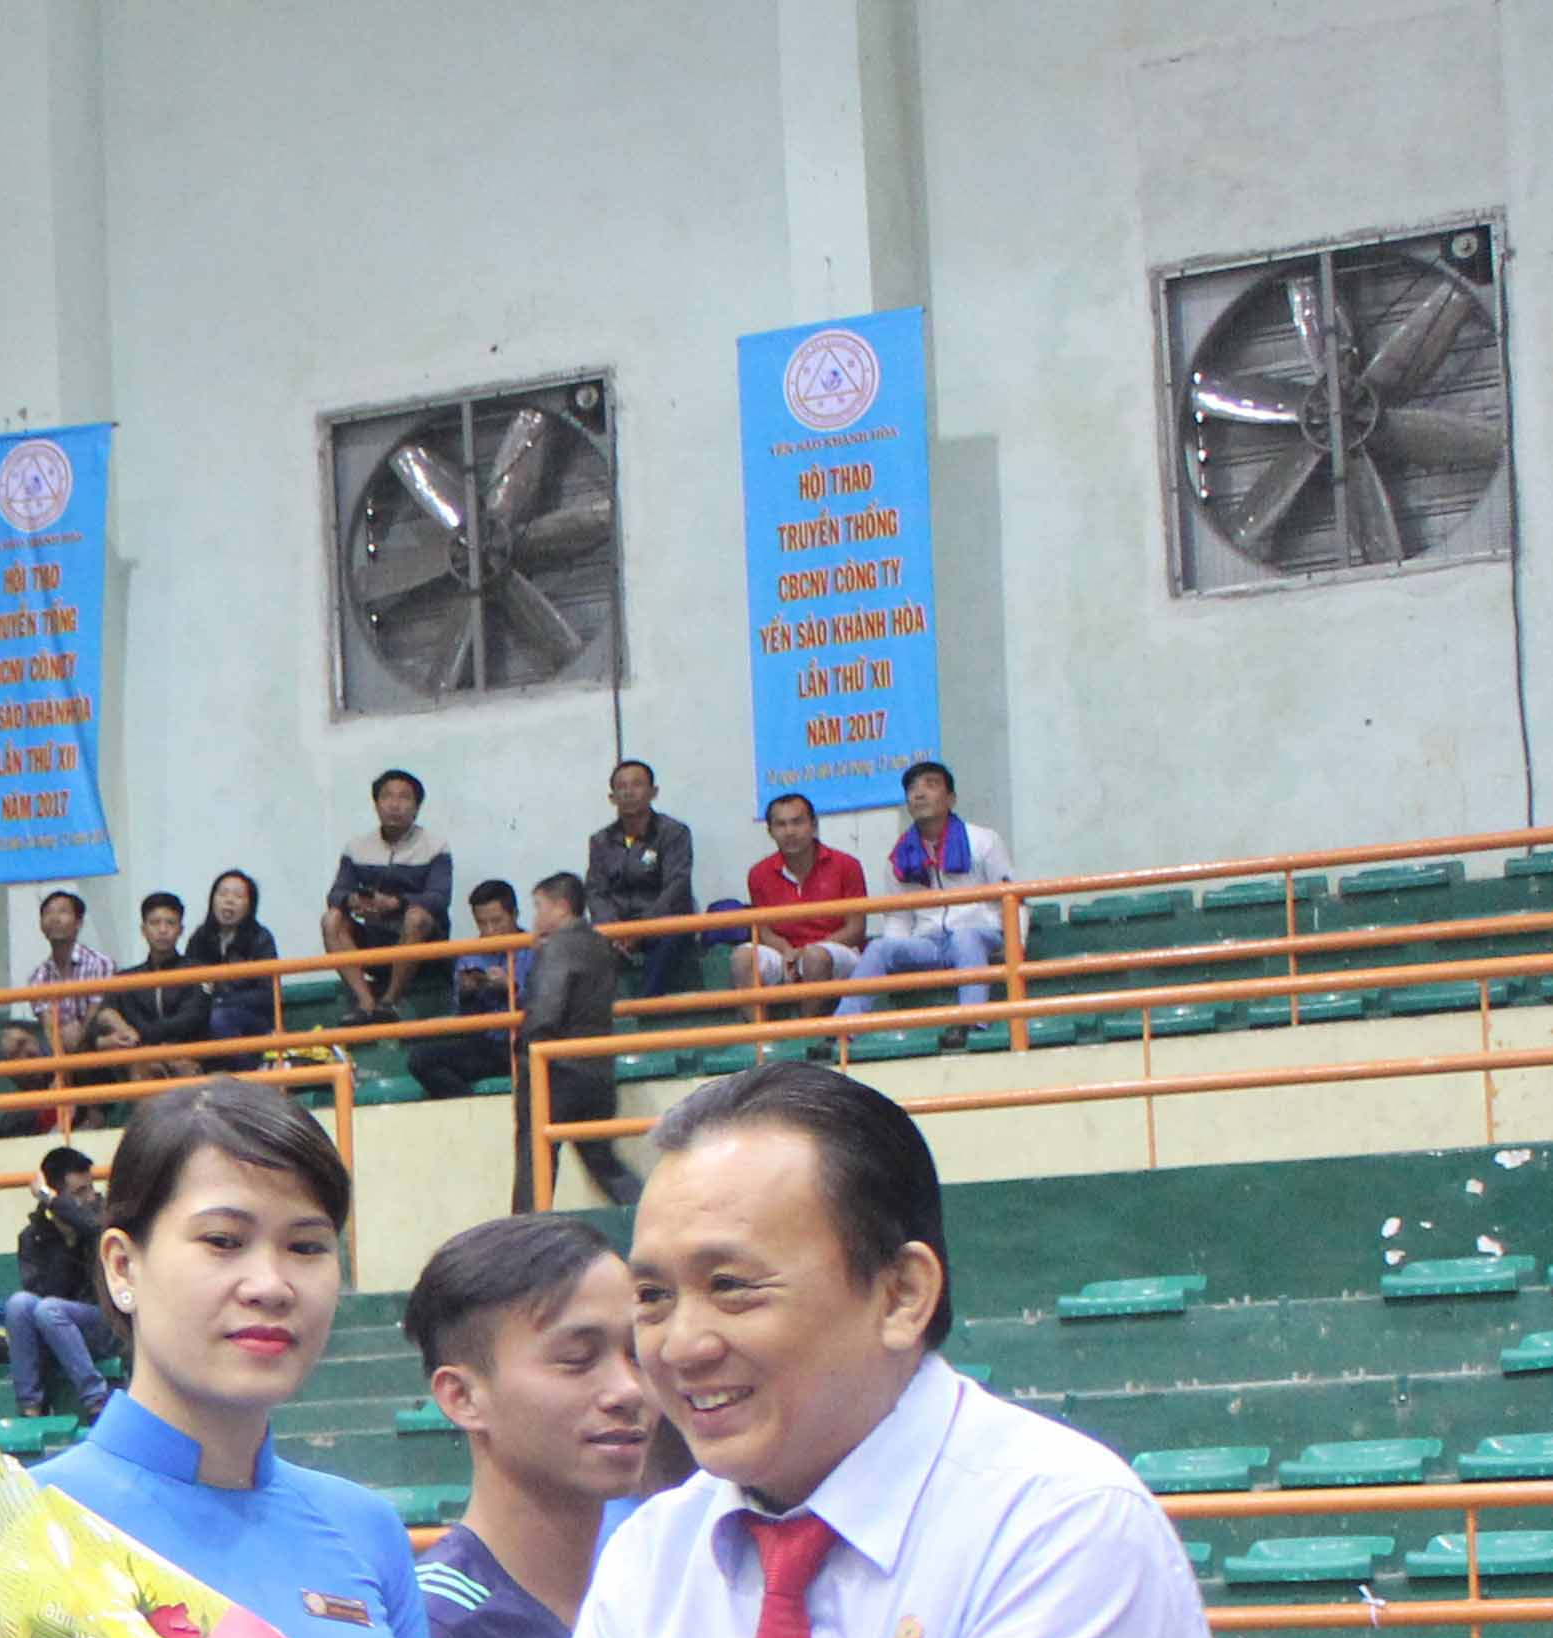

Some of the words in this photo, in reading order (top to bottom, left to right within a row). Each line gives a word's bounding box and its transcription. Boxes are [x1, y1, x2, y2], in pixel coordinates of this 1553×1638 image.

[798, 465, 826, 501] HỘI
[829, 461, 873, 495] THAO
[842, 499, 898, 543] THỐNG
[778, 570, 831, 603] CBCNV
[833, 561, 878, 596] CÔNG
[880, 558, 903, 587] TY
[759, 618, 792, 655] YẾN
[831, 606, 888, 645] KHÁNH
[870, 659, 893, 688] XII
[845, 711, 887, 743] 2017
[36, 789, 69, 818] 2017
